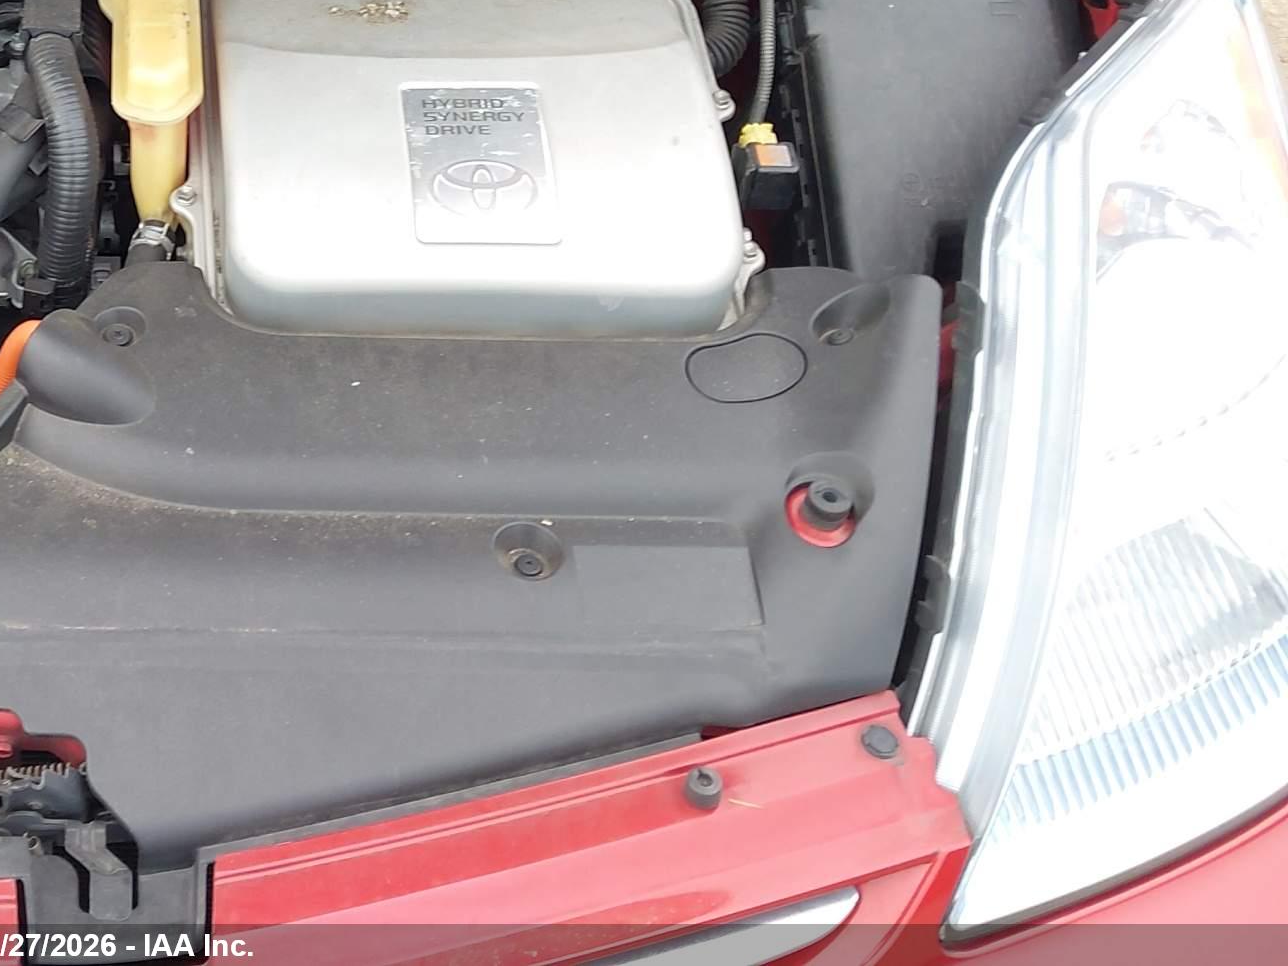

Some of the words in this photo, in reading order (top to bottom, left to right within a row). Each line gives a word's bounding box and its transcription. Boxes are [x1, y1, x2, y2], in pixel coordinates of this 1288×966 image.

[422, 98, 504, 109] HYBRID
[423, 111, 525, 122] SYNERGY
[425, 124, 491, 135] DRIVE
